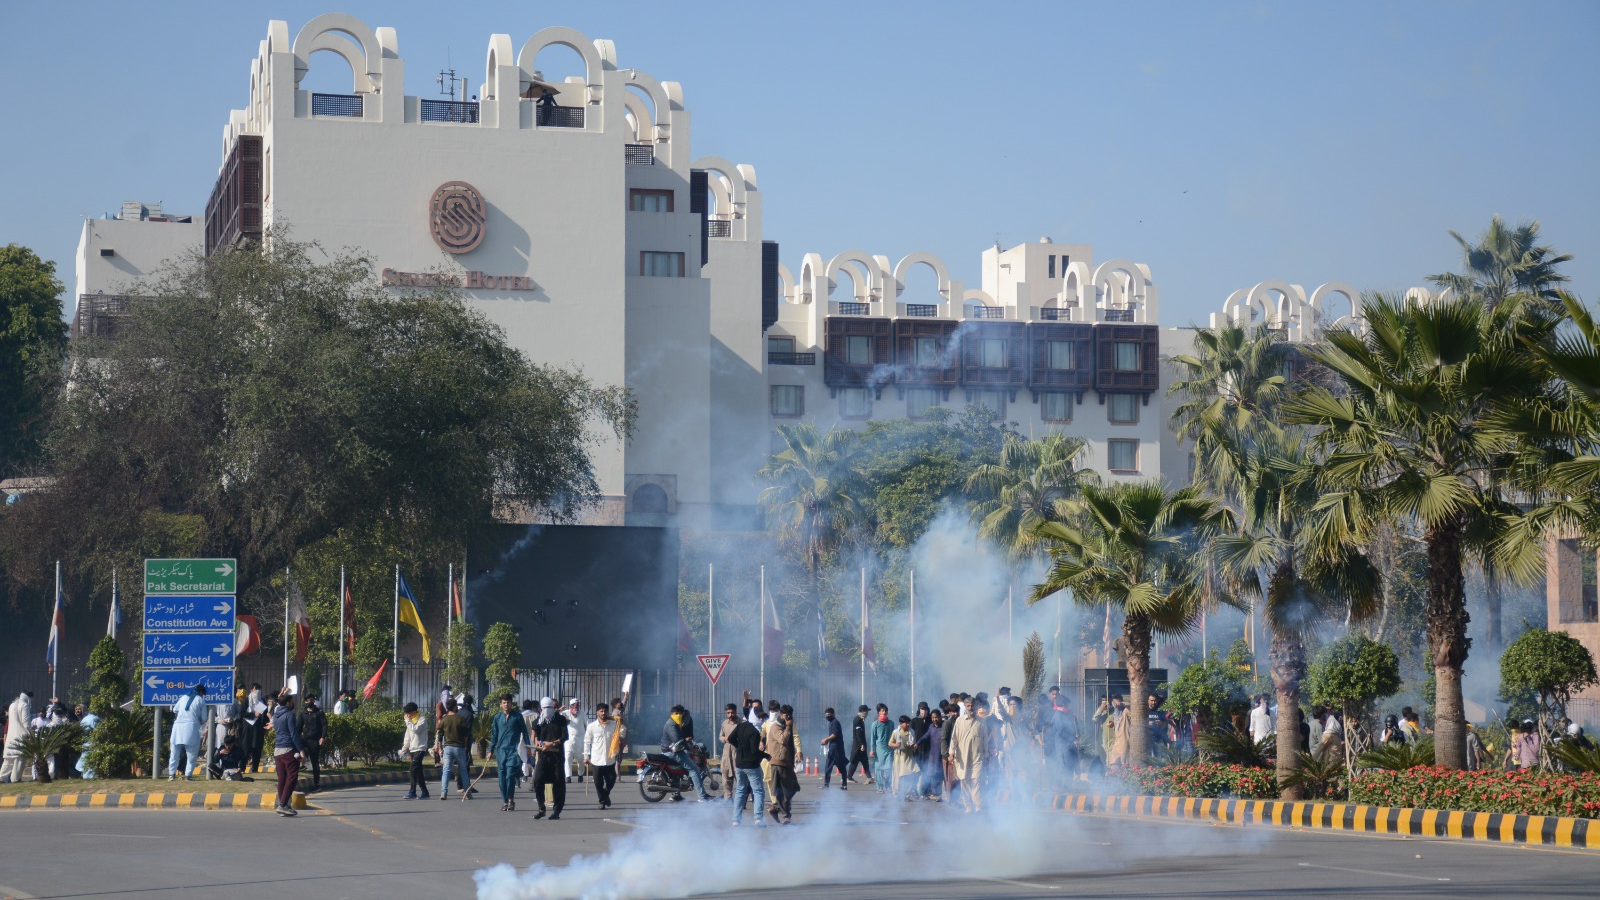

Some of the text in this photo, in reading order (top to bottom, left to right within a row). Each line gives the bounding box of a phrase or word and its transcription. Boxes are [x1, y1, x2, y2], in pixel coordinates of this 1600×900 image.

[466, 271, 535, 290] HOTEL
[178, 563, 194, 579] پاک
[169, 582, 225, 590] Secretariat
[147, 619, 227, 627] Constitution Ave
[146, 655, 211, 665] Serena Hotel
[166, 681, 185, 690] (G-6)
[152, 693, 230, 703] Aabpa arket
